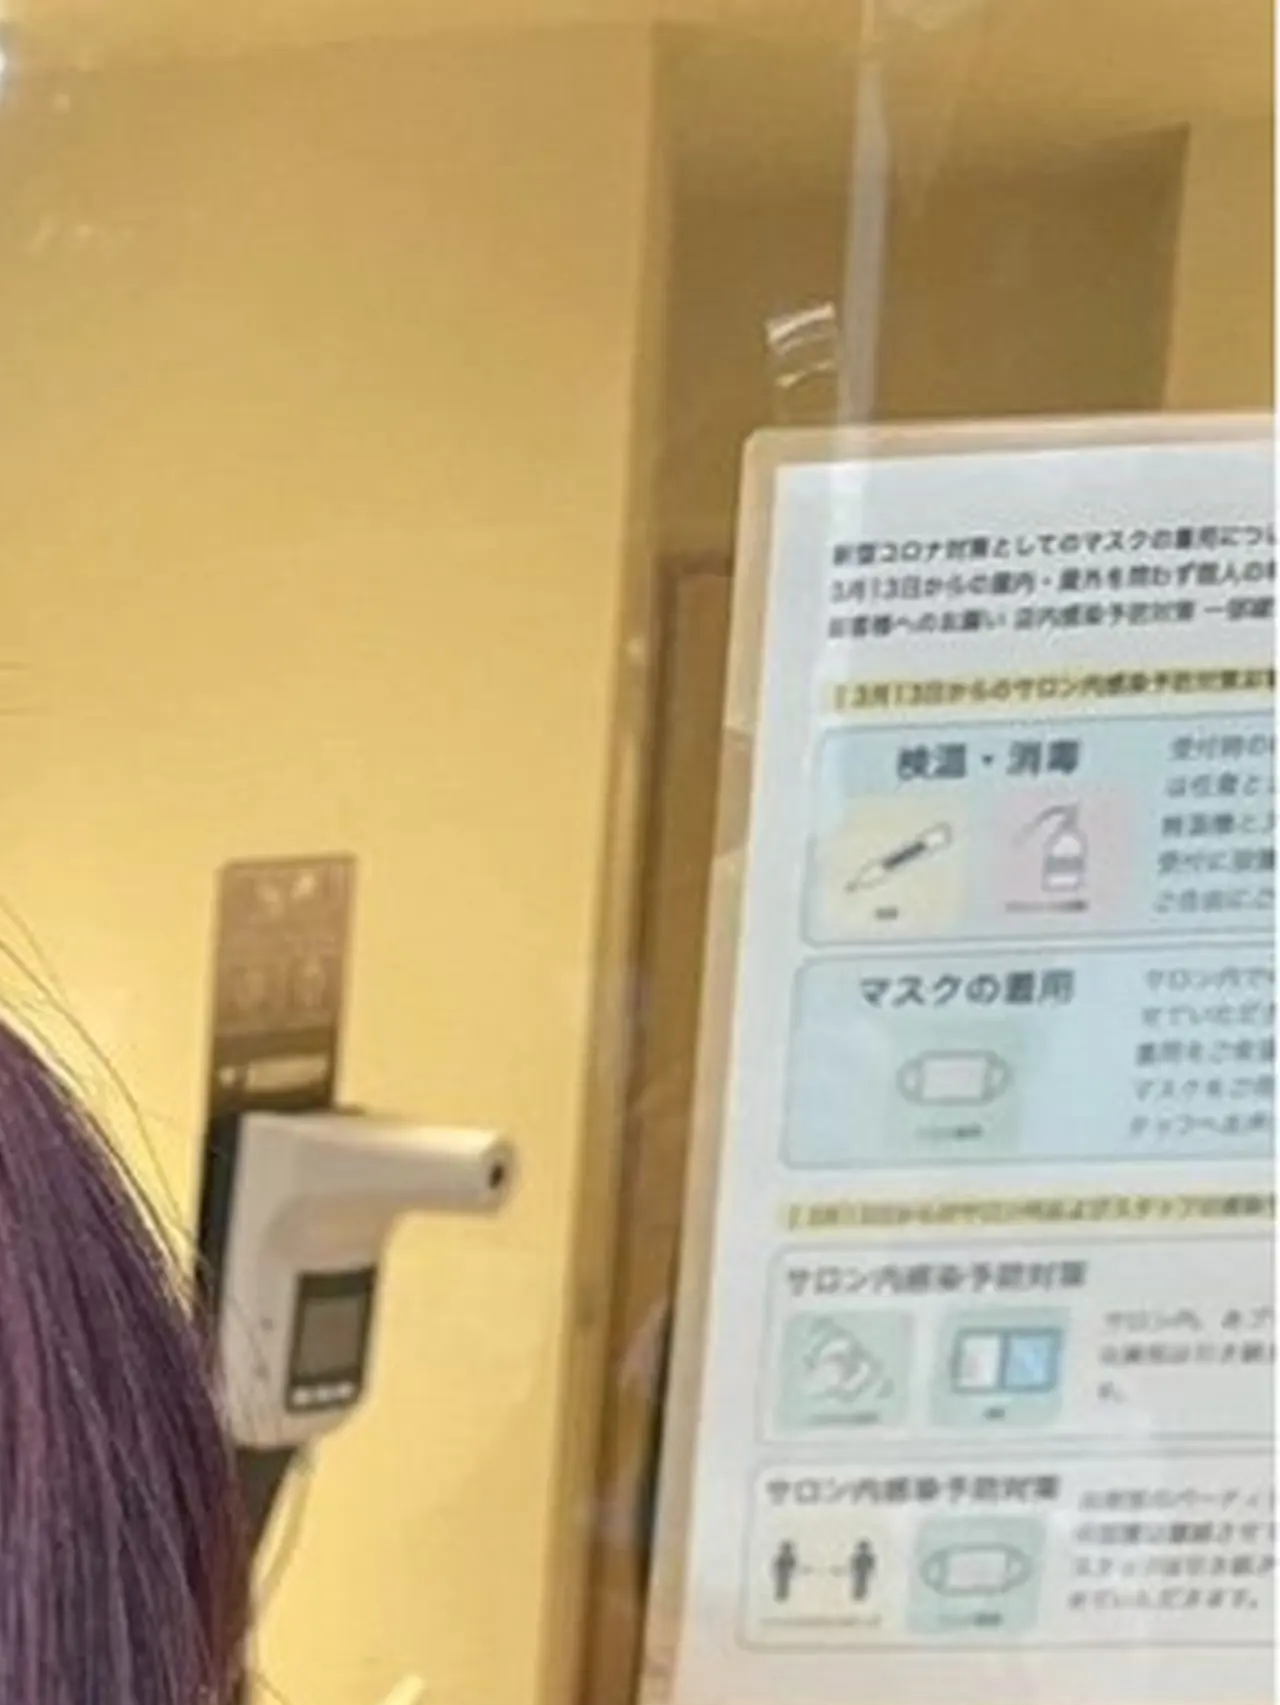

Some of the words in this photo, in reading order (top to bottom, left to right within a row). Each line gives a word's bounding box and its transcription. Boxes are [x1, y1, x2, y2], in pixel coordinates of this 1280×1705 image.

[896, 740, 1080, 780] 検温・消毒
[859, 969, 1075, 1008] マスクの着用
